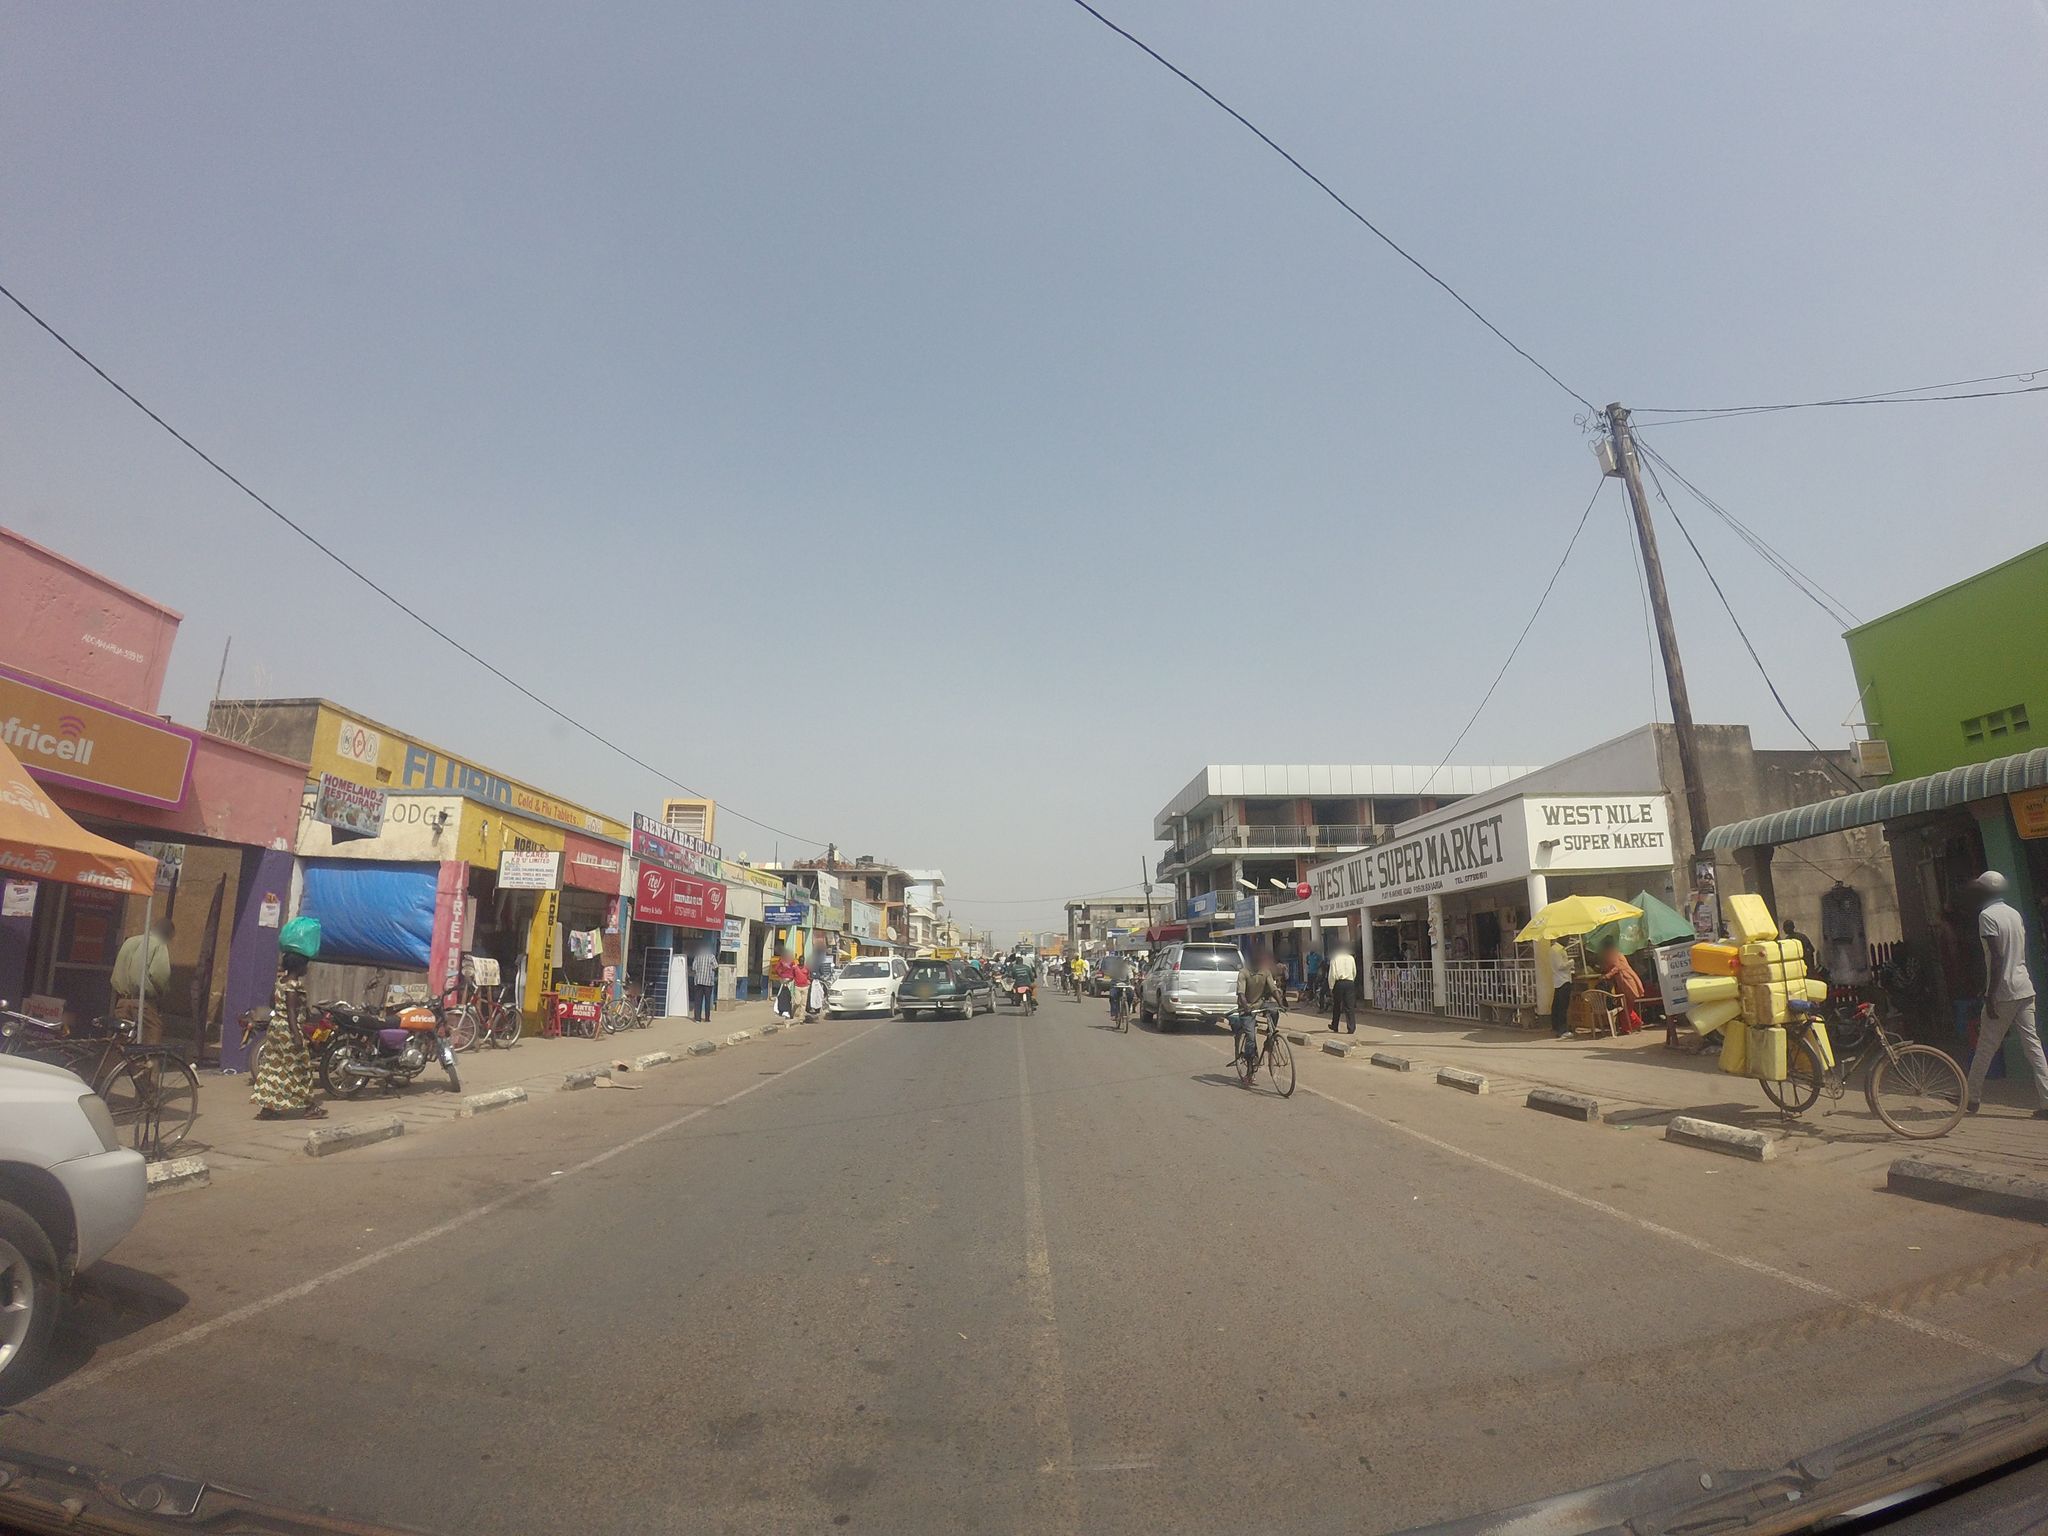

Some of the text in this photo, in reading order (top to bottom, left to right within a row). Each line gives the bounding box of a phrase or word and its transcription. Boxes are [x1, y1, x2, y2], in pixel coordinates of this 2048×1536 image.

[0, 716, 93, 765] fricell
[0, 790, 50, 818] cell
[324, 786, 381, 812] RESTAURANT
[517, 792, 533, 810] Cold
[534, 799, 541, 812] &
[384, 803, 456, 827] ODGE
[1541, 804, 1653, 826] WEST NILE
[642, 815, 694, 850] RENEWABLE
[706, 843, 720, 859] LTD
[1563, 832, 1664, 850] SUPER MARKET
[1317, 814, 1504, 900] WEST NILE SUPER MARKET
[77, 870, 133, 891] africell
[648, 873, 662, 889] itel
[450, 879, 463, 943] AIRTEL
[545, 892, 557, 960] MOBILE
[573, 1003, 596, 1011] AIRTEL
